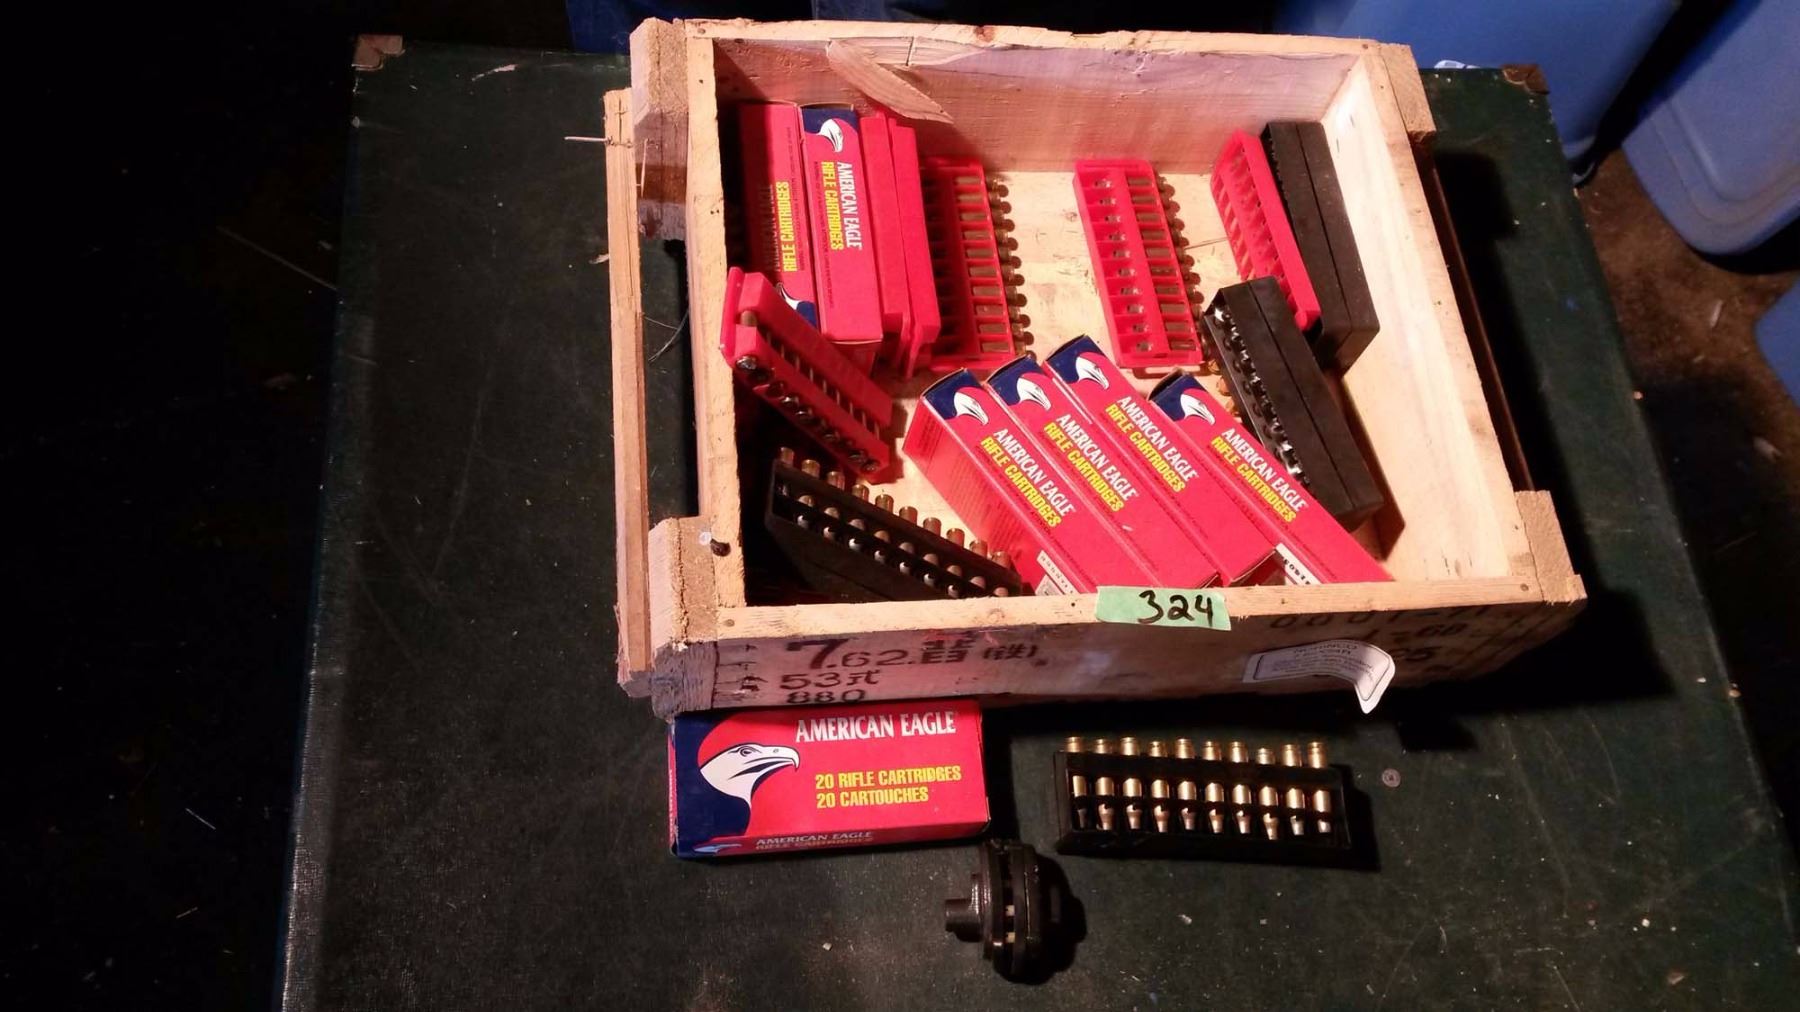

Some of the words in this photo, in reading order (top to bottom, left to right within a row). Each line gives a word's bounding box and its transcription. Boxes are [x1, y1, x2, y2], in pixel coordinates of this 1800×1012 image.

[821, 161, 836, 190] RIFLE
[837, 161, 857, 217] AMERICAN
[776, 181, 795, 242] CARTRIDGES
[825, 190, 844, 250] CARTRIDGES
[843, 217, 861, 249] EAGLE
[781, 242, 797, 272] RIFLE
[1044, 422, 1073, 452] RIFLE
[1067, 449, 1124, 512] CARTRIDGES
[1056, 413, 1109, 469] AMERICAN
[1102, 465, 1138, 501] EAGLE
[1105, 404, 1133, 434] RIFLE
[1129, 430, 1185, 492] CARTRIDGES
[1117, 396, 1170, 450] AMERICAN
[1163, 446, 1197, 482] EAGLE
[981, 436, 1010, 467] RIFLE
[1004, 464, 1061, 527] CARTRIDGES
[993, 428, 1047, 484] AMERICAN
[1040, 480, 1074, 517] EAGLE
[1211, 435, 1239, 466] RIFLE
[1236, 462, 1296, 523] CARTRIDGES
[1221, 428, 1276, 481] AMERICAN
[1271, 476, 1307, 512] EAGLE
[1137, 590, 1214, 627] 324
[795, 713, 895, 744] AMERICAN
[900, 710, 957, 737] EAGLE
[815, 774, 835, 790] 20
[838, 771, 876, 788] RIFLE
[878, 765, 961, 786] CARTRIDGES
[816, 792, 836, 809] 20
[839, 786, 929, 807] CARTOUCHES
[756, 834, 828, 845] AMERICAN
[832, 831, 873, 840] EAGLE
